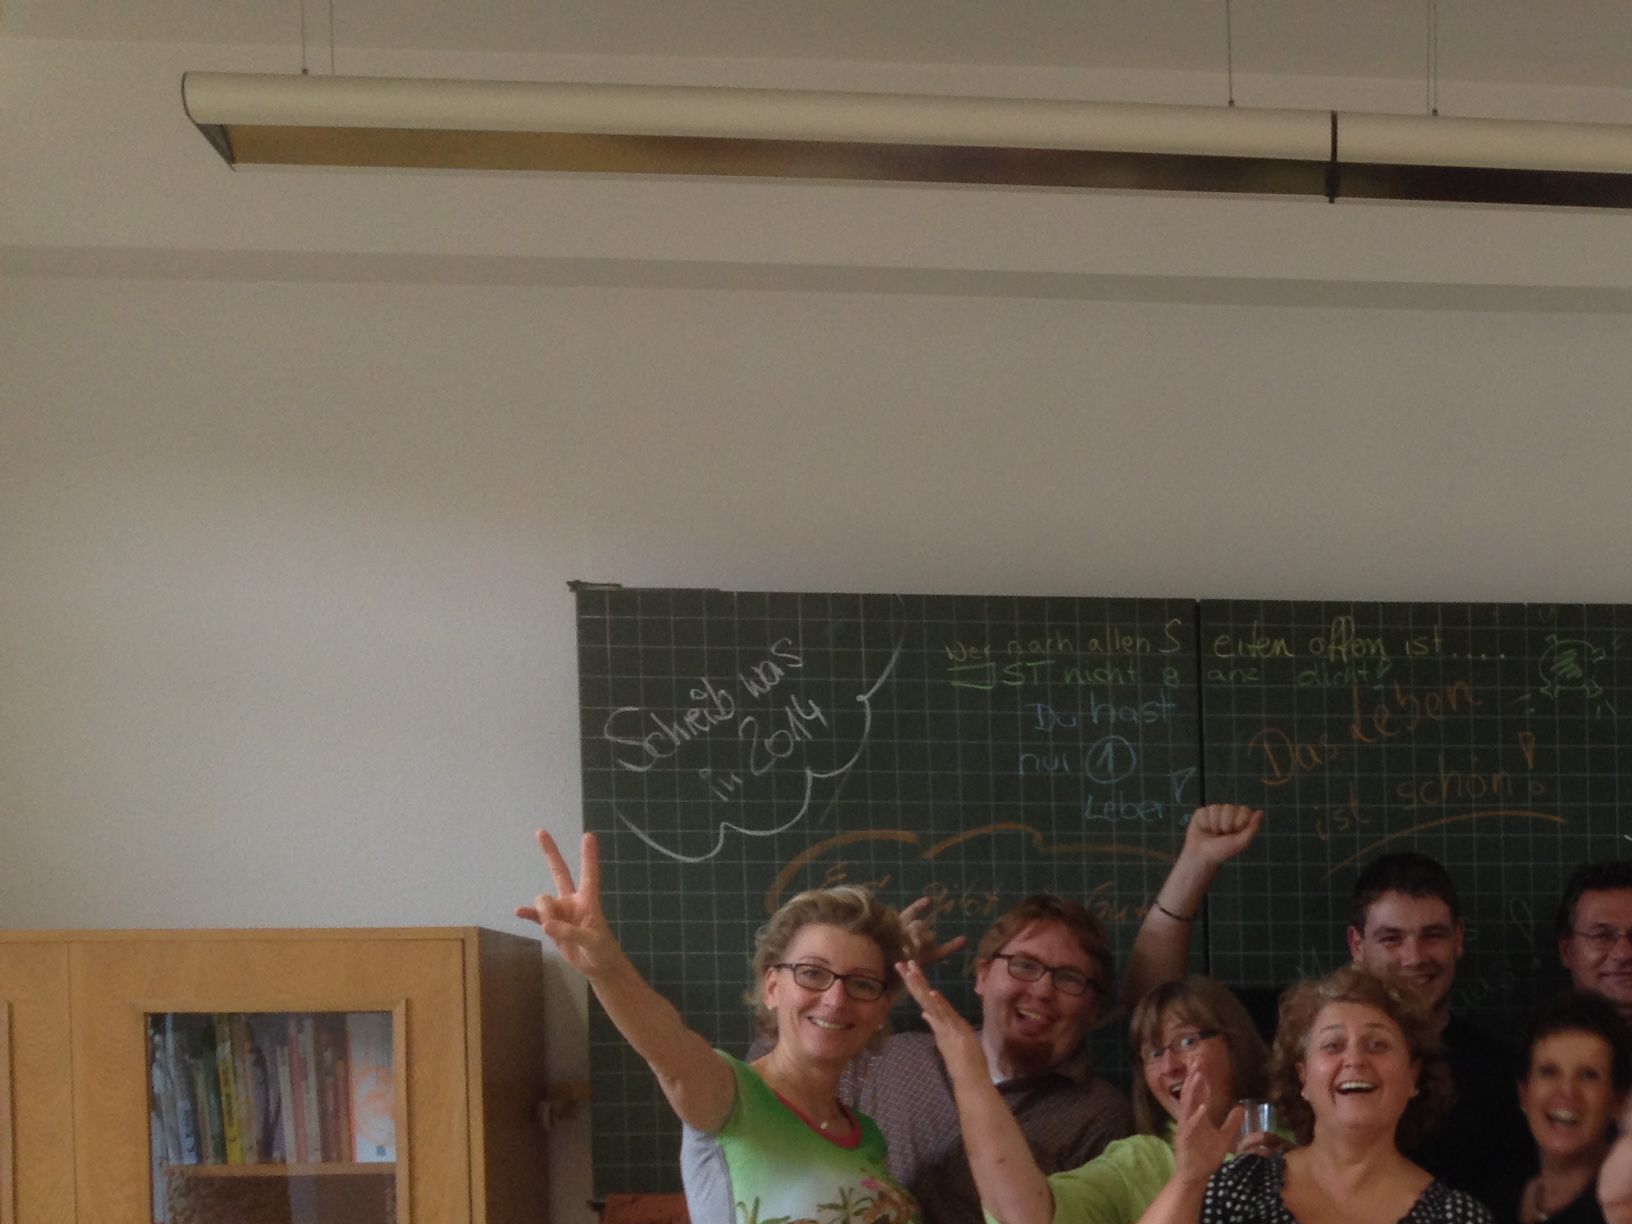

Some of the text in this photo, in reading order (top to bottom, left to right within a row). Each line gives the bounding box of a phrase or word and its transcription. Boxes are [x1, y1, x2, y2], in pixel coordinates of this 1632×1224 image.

[1007, 630, 1073, 656] nach
[1088, 625, 1151, 654] allen
[1309, 615, 1384, 663] offen
[603, 637, 804, 773] Schreib was
[1064, 663, 1138, 686] nicht
[1022, 690, 1176, 732] Du hast
[1248, 680, 1483, 787] Das Leben
[698, 694, 829, 802] in 2014
[1314, 778, 1371, 841] ist
